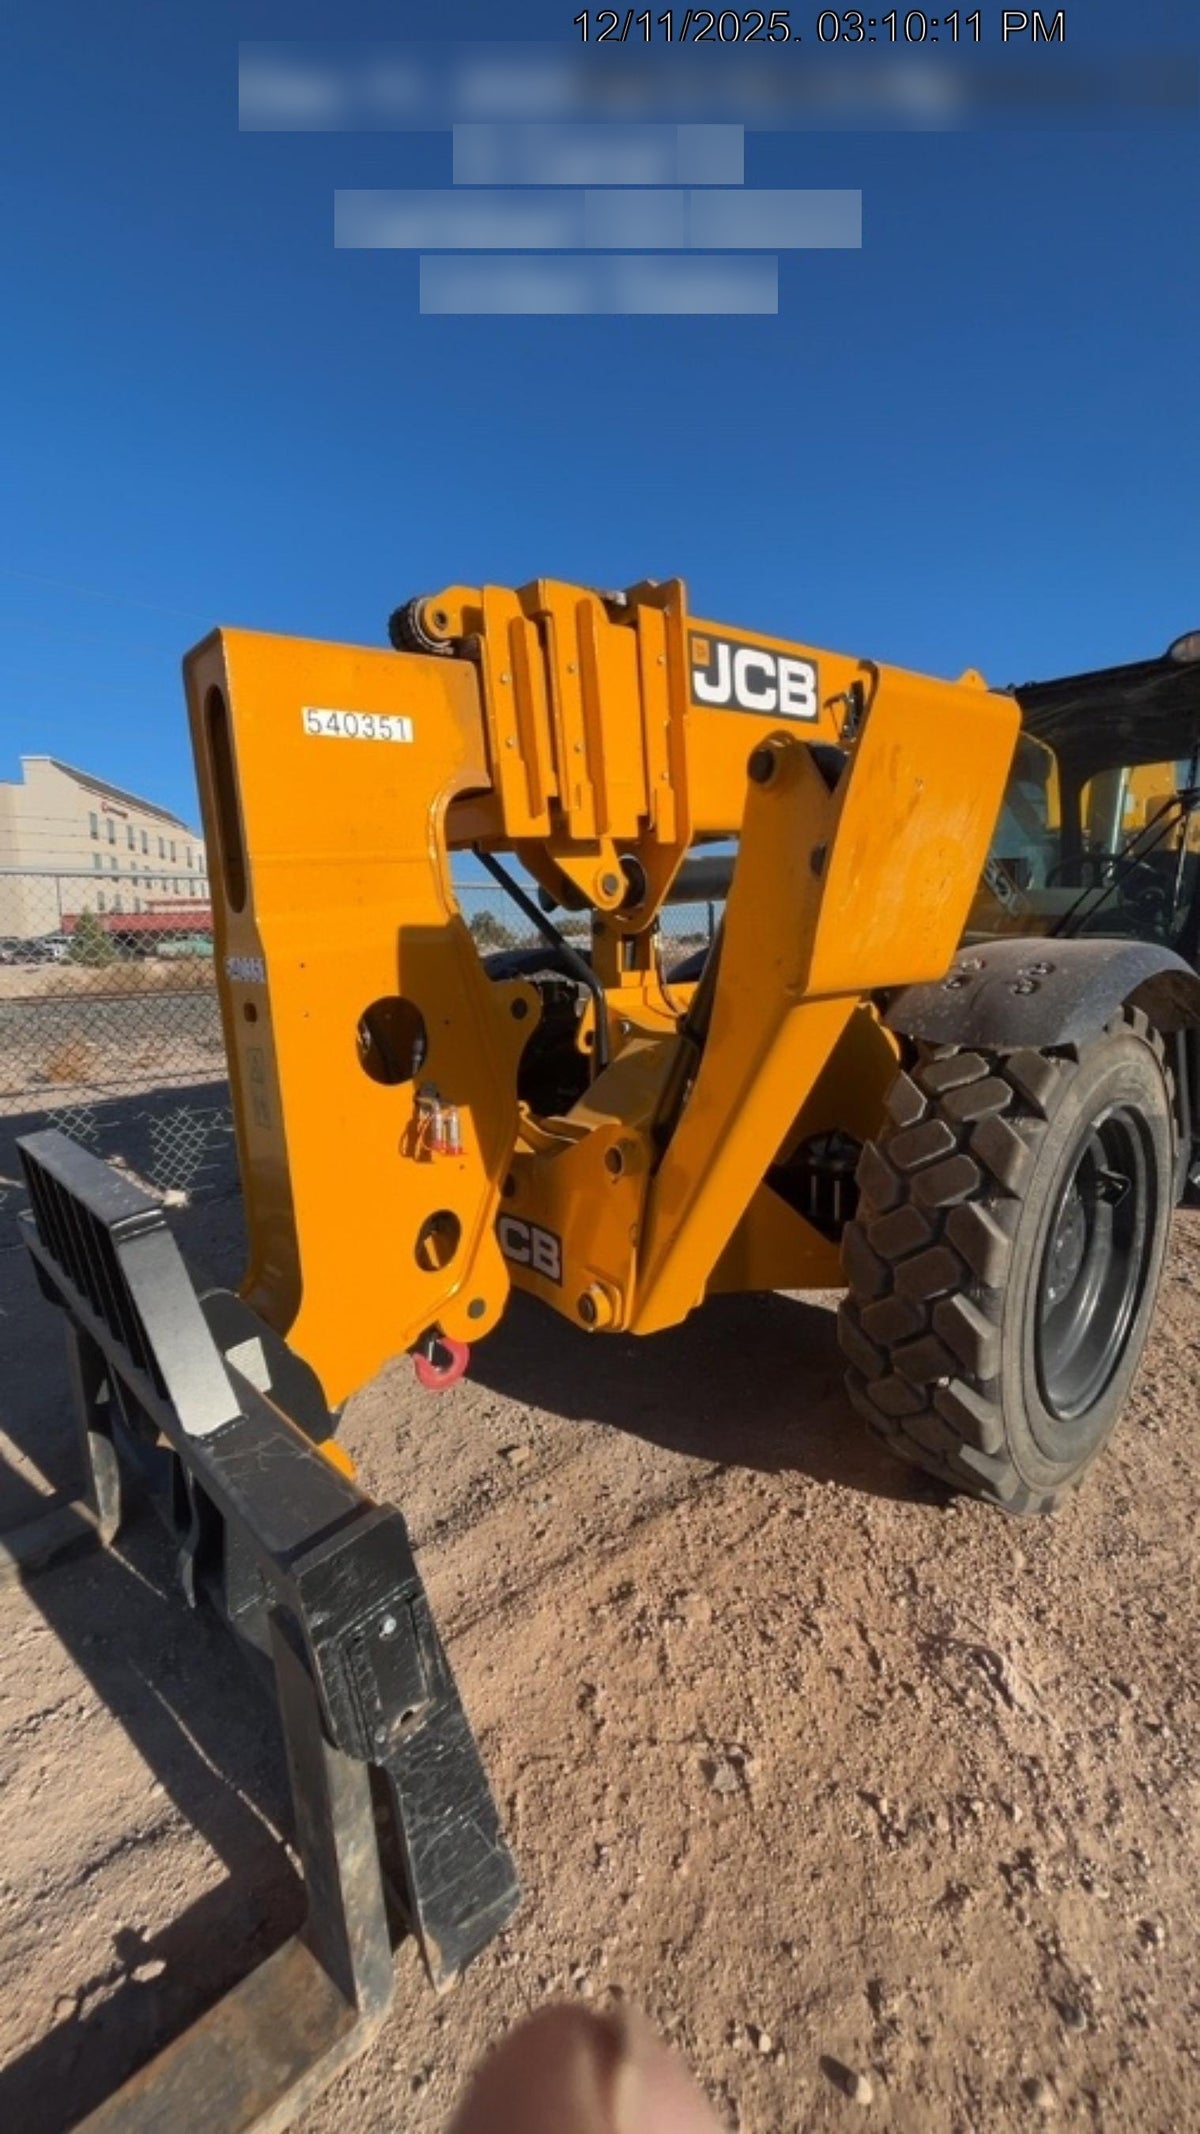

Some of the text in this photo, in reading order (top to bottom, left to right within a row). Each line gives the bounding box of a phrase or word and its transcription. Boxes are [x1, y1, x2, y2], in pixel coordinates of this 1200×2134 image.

[693, 641, 817, 717] JCB
[307, 708, 407, 741] 540351
[498, 1216, 561, 1280] CB
